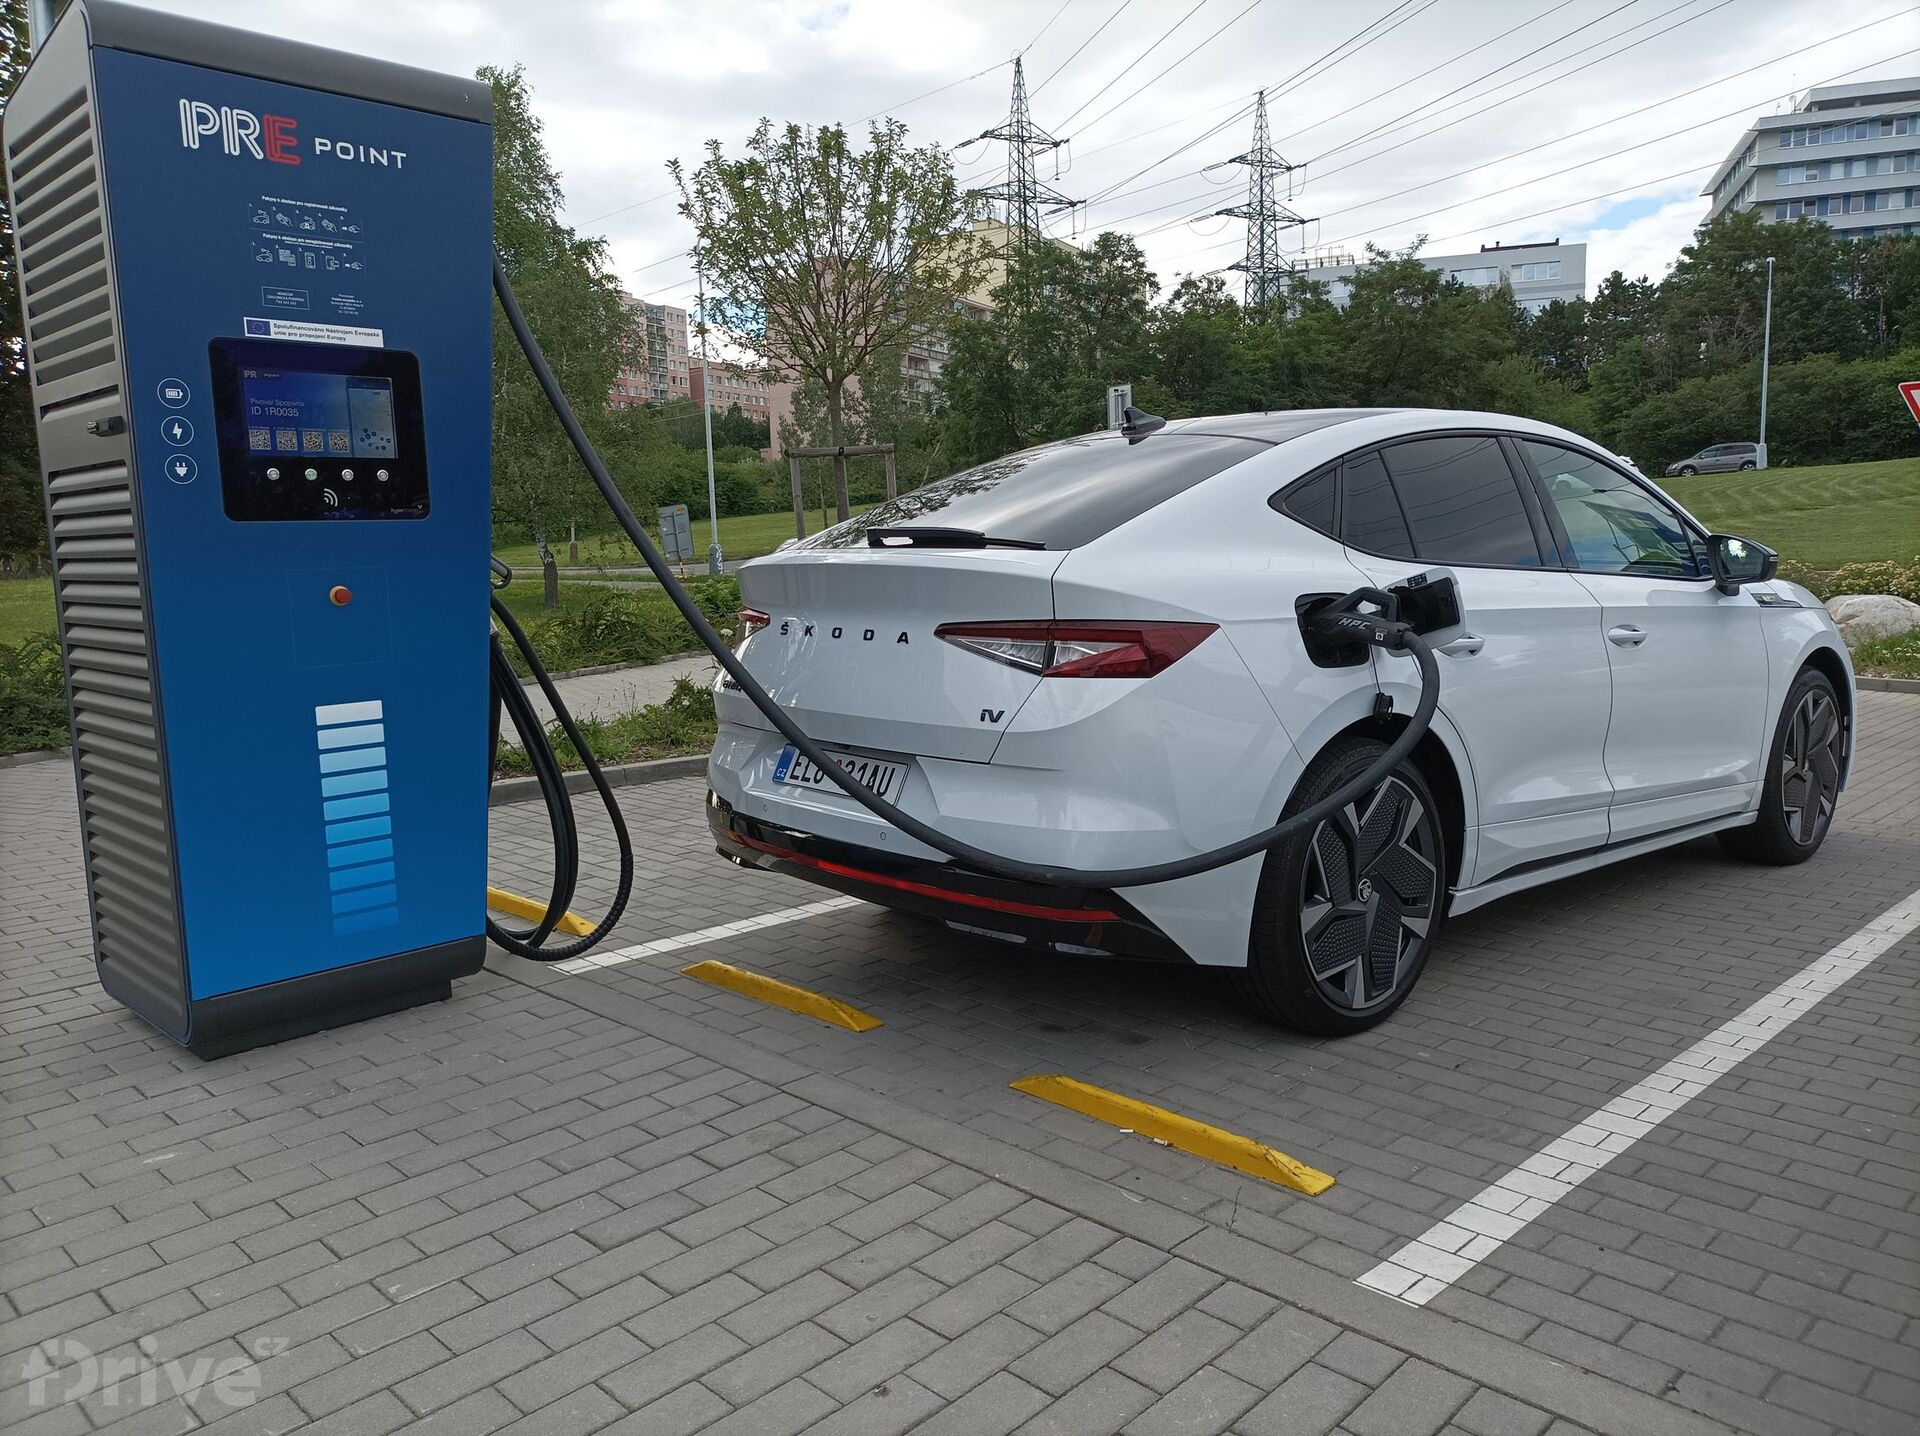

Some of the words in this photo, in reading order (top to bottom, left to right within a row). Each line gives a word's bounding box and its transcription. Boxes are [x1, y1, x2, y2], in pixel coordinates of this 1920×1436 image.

[179, 99, 301, 165] PRE
[315, 137, 407, 169] POINT
[273, 322, 325, 333] Spolufinancováno
[325, 327, 353, 336] Nástrojem
[300, 332, 326, 340] propojení
[326, 334, 346, 342] Evropy
[251, 406, 261, 415] ID
[264, 406, 299, 417] 1R0035
[1338, 617, 1371, 630] HPC
[780, 621, 910, 645] ŠKODA
[776, 768, 787, 778] CZ
